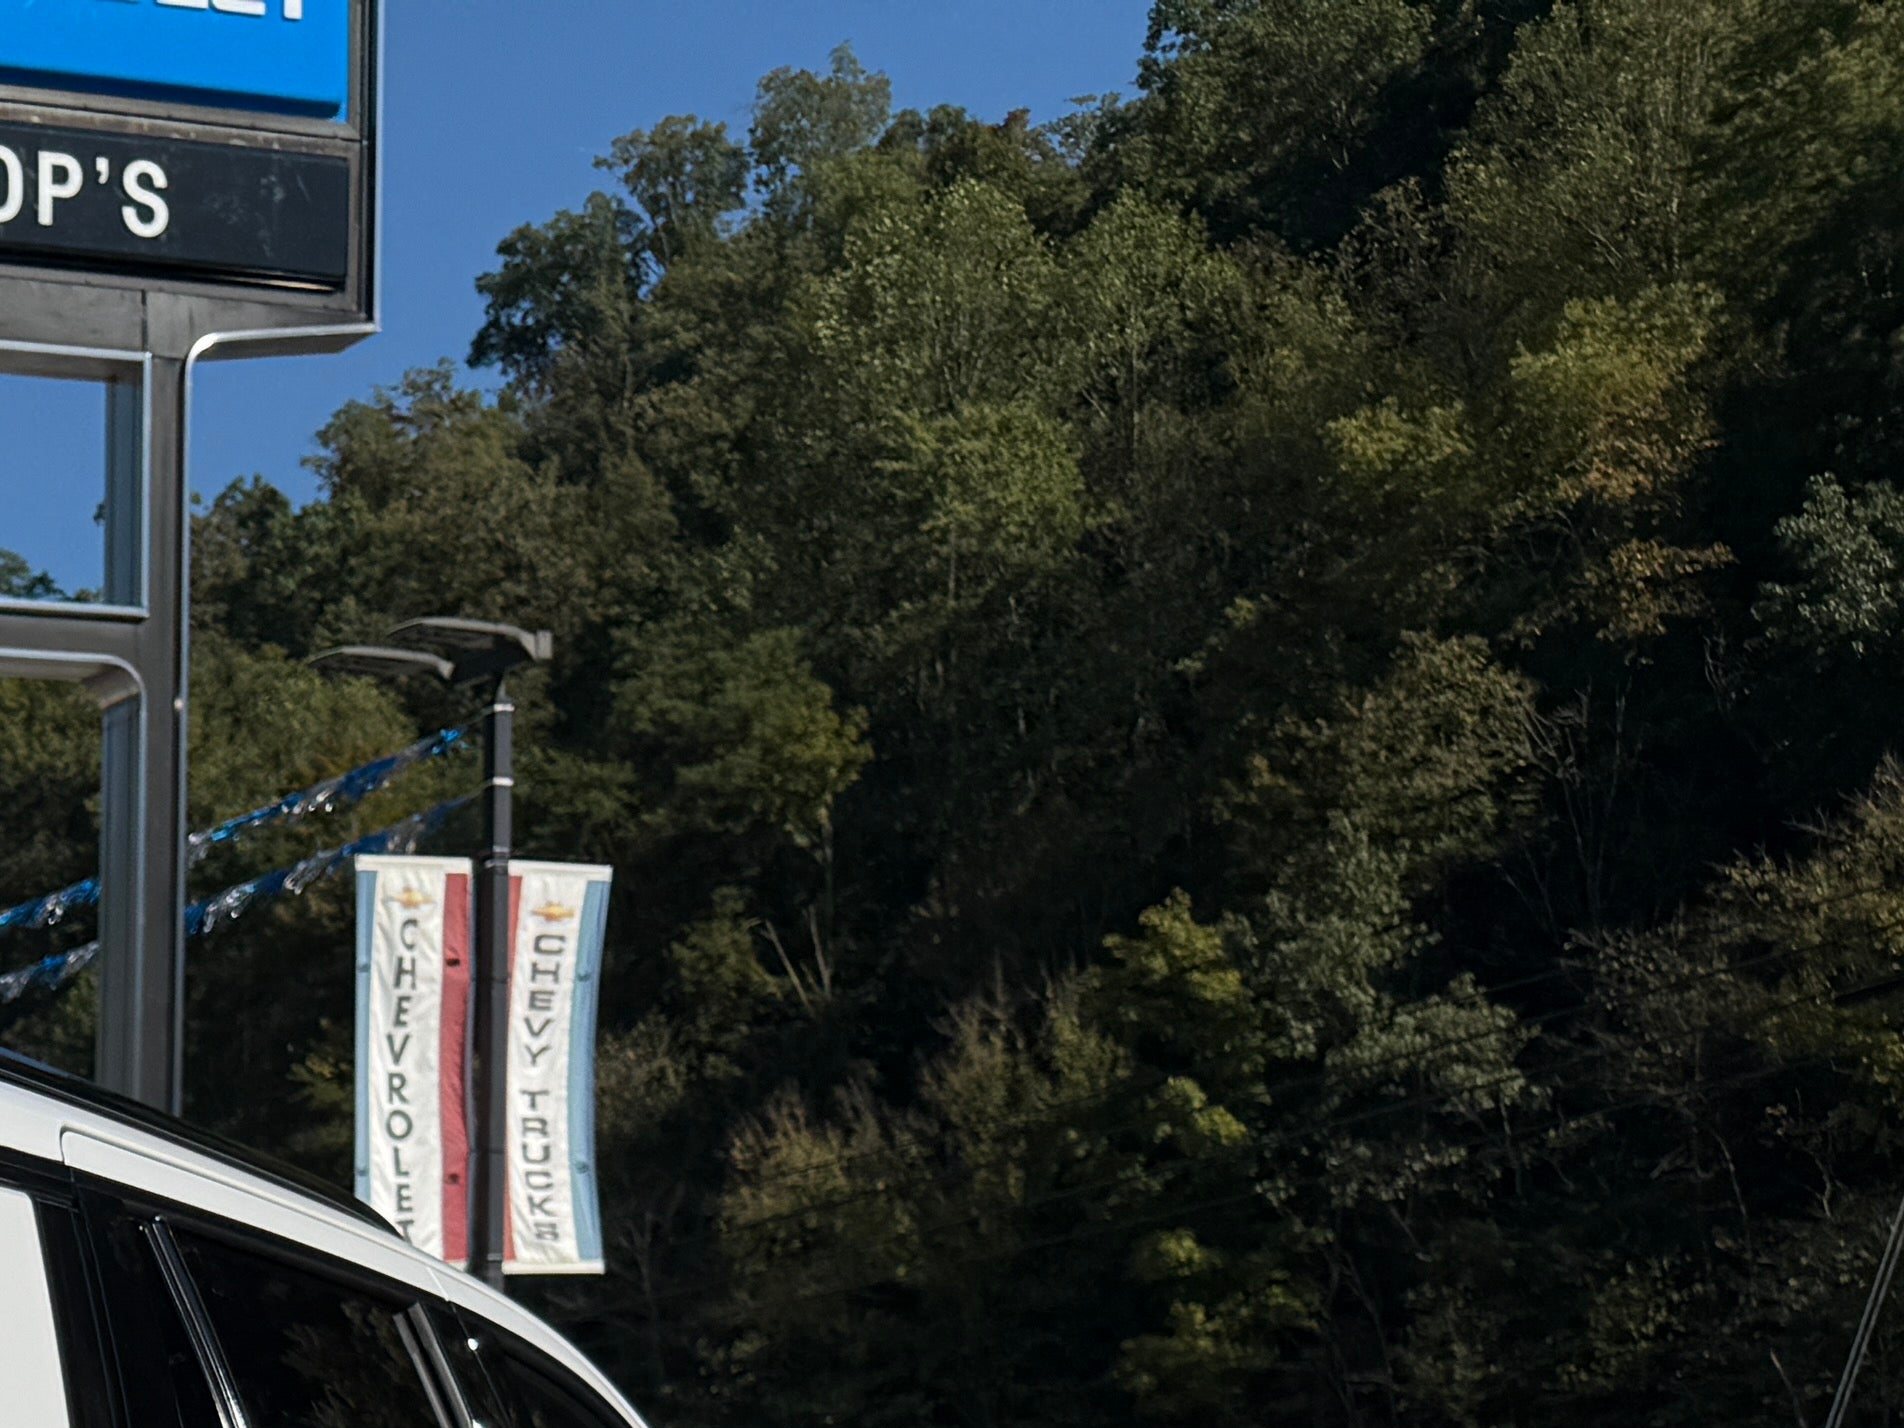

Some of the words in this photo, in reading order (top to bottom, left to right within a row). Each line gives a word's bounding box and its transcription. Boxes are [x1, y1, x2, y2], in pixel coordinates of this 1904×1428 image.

[522, 933, 568, 1066] CHEVY
[385, 918, 419, 1243] CHEVROLET
[520, 1088, 560, 1242] TRUCKS
